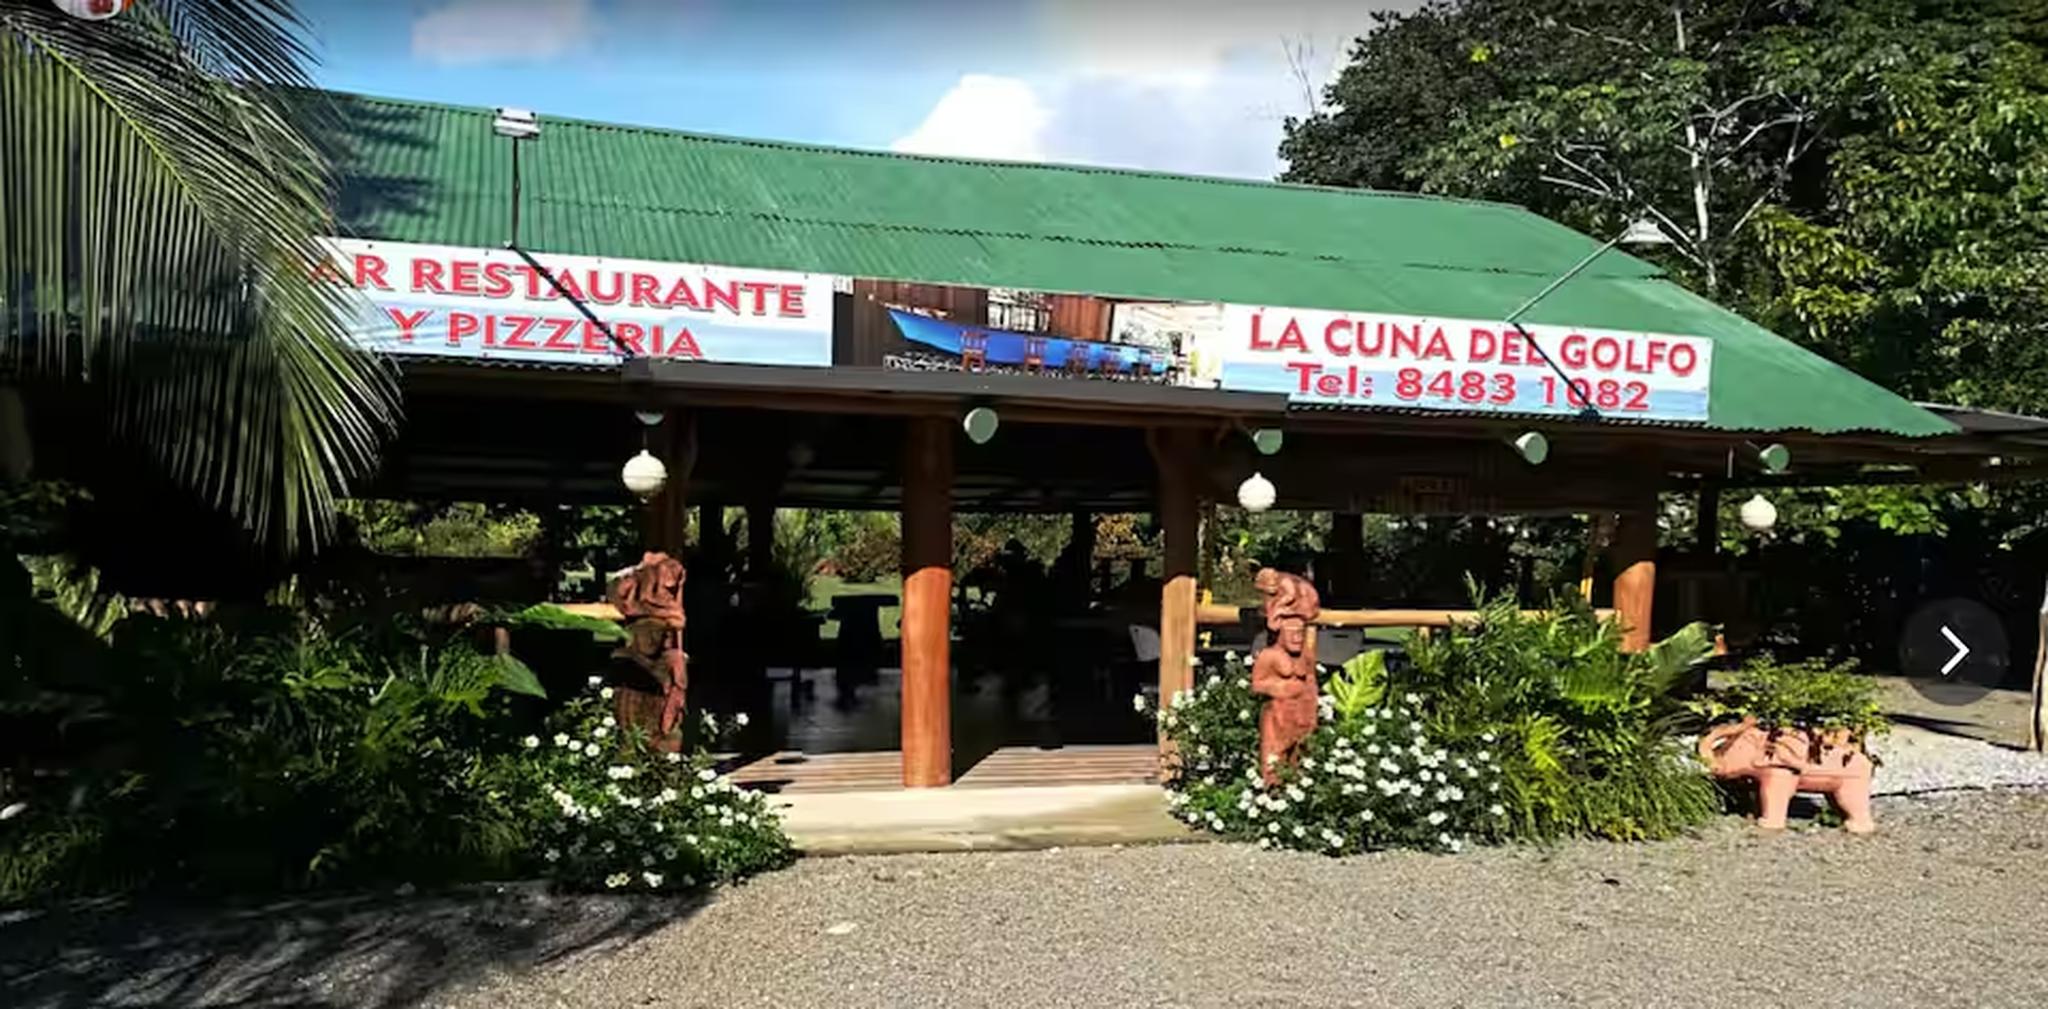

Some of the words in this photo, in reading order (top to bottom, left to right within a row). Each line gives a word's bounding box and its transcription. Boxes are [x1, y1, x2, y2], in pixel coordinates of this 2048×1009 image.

[411, 258, 806, 316] RESTAURANTE
[388, 308, 427, 343] Y
[446, 311, 702, 359] PIZZERIA
[1249, 313, 1308, 353] LA
[1323, 318, 1455, 362] CUNA
[1468, 327, 1548, 366] DEL
[1558, 333, 1698, 377] GOLFO
[1286, 360, 1374, 397] Tel:
[1395, 366, 1517, 405] 8483
[1541, 375, 1651, 411] 1082
